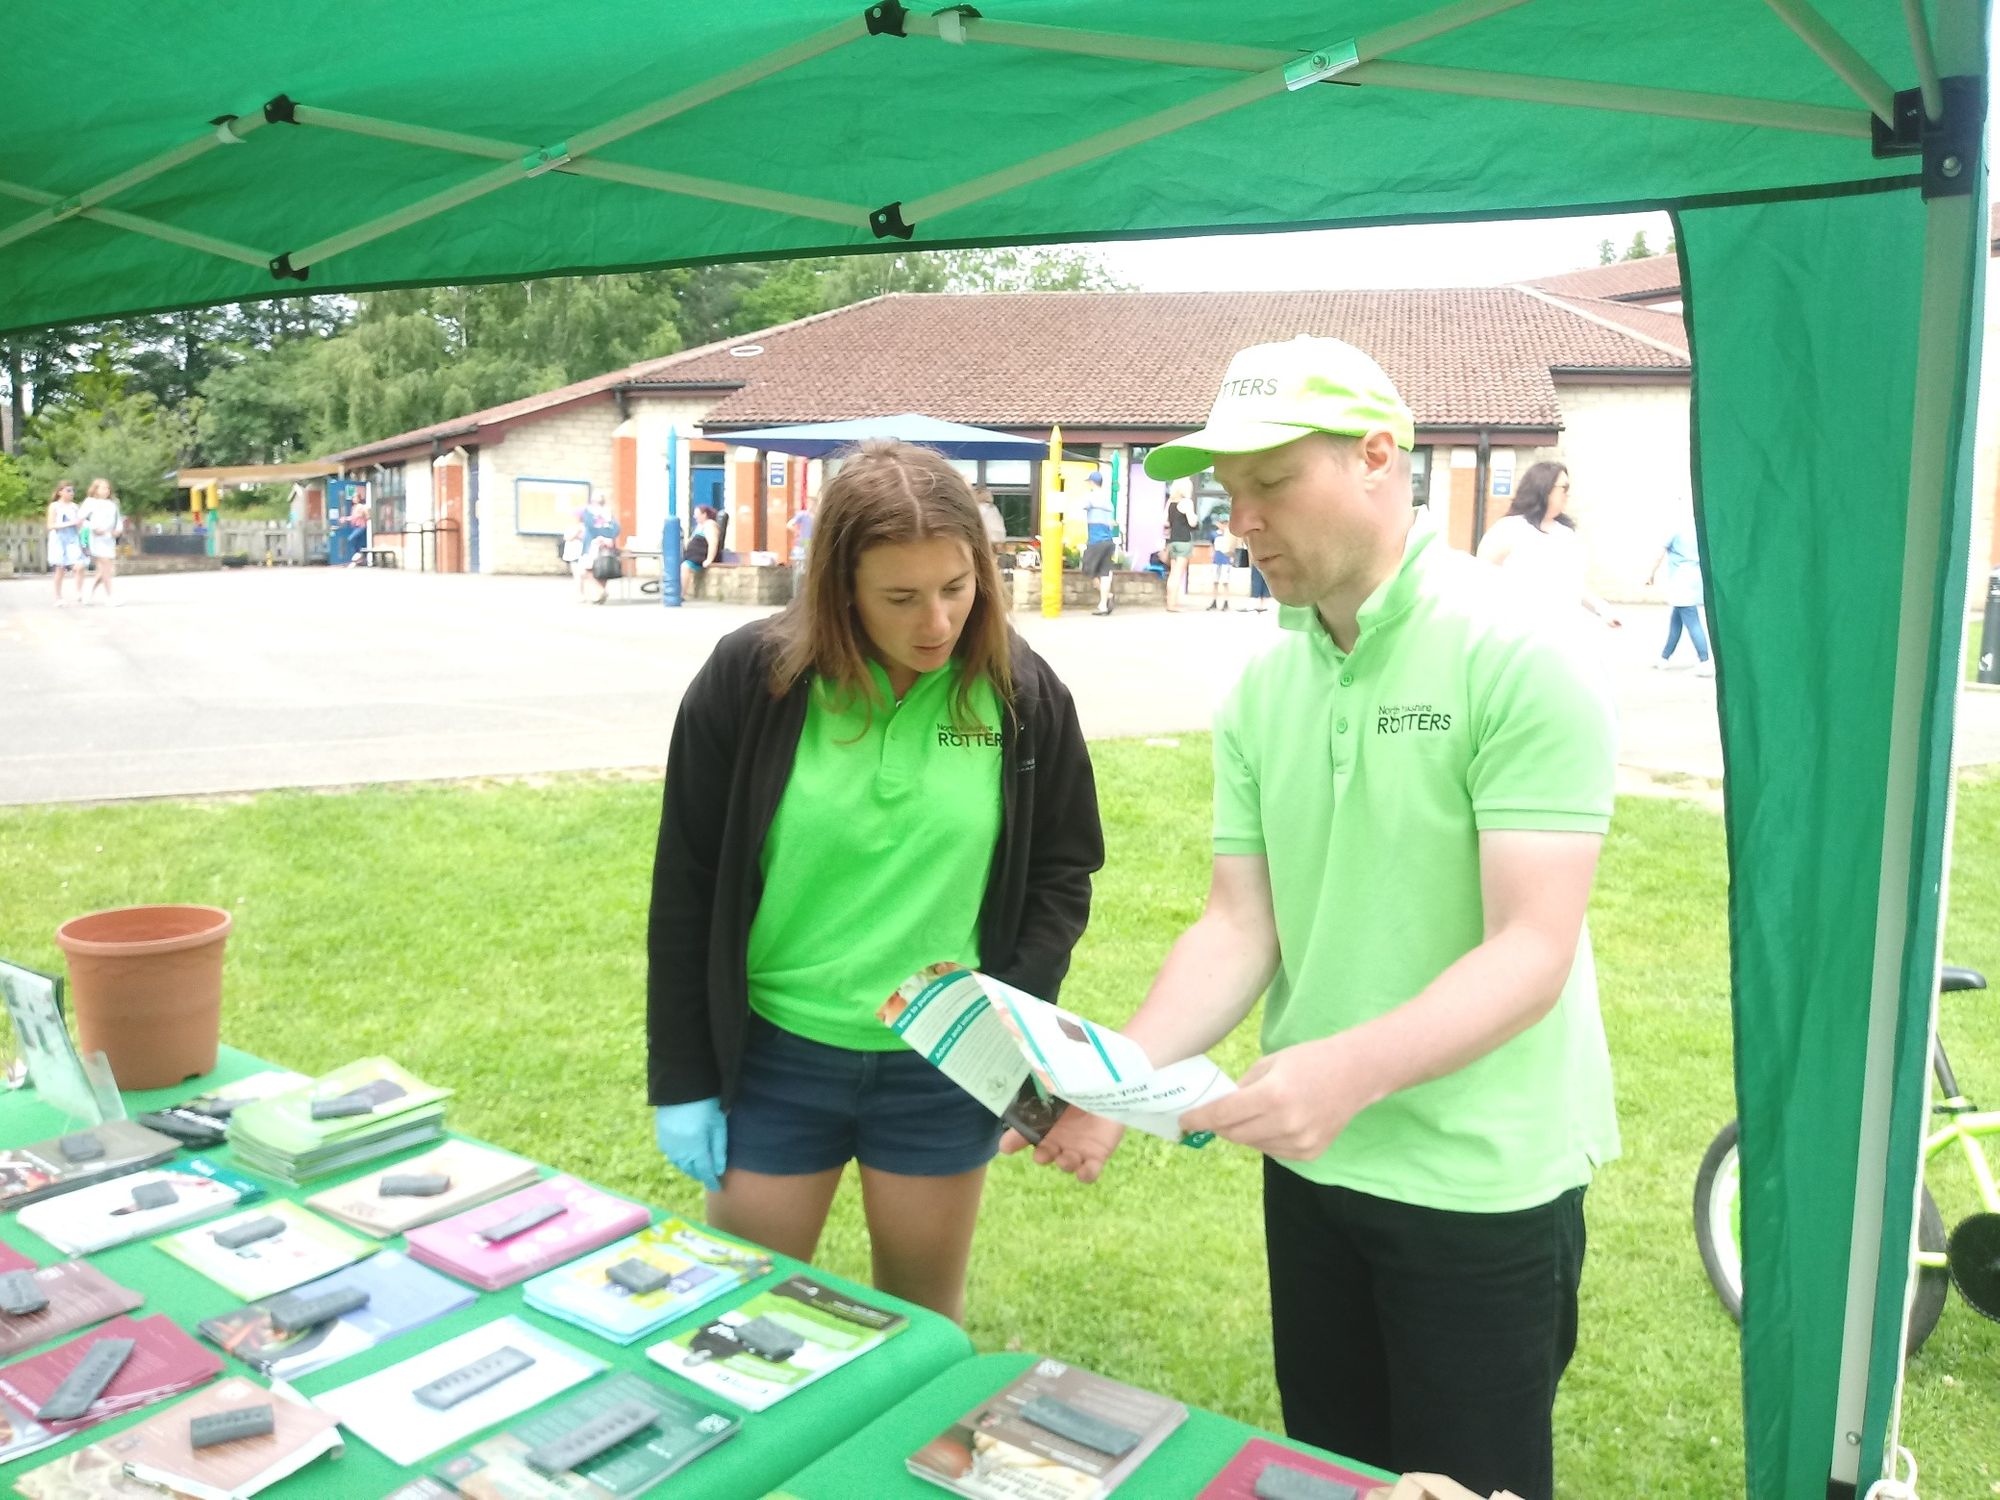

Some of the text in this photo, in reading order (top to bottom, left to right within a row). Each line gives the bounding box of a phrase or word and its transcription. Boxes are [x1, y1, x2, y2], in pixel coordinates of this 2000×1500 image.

[1222, 378, 1278, 397] TTERS
[1377, 713, 1452, 735] ROTTERS
[938, 732, 1003, 747] ROTTER
